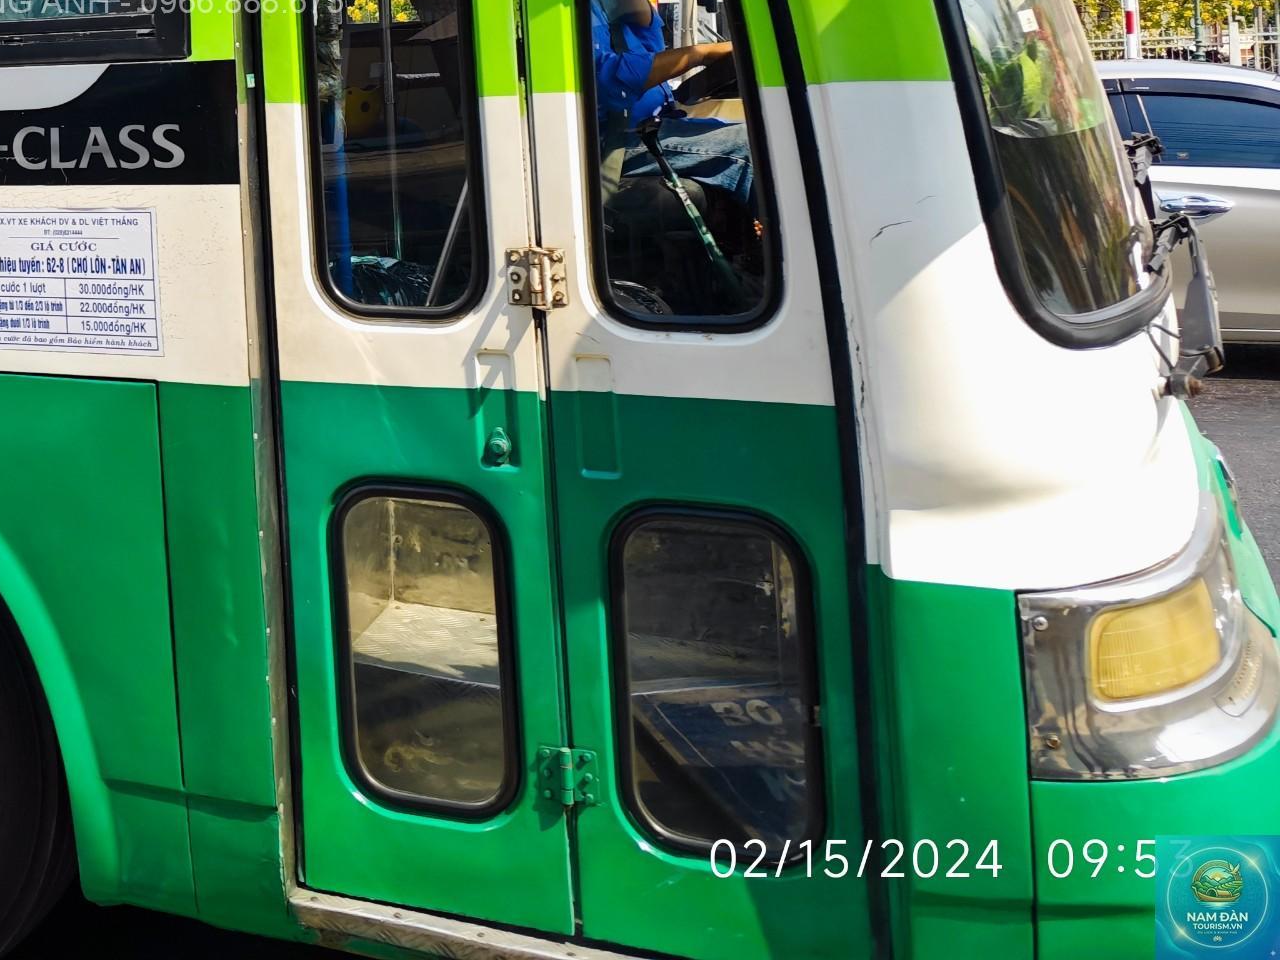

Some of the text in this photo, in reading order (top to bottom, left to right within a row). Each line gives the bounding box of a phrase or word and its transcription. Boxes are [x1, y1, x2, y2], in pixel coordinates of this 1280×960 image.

[19, 218, 28, 226] XE
[30, 216, 57, 226] KHÁCH
[59, 218, 69, 226] DV
[71, 218, 77, 226] &
[79, 218, 89, 226] DL
[92, 217, 108, 227] VIỆT
[111, 216, 139, 226] THẮNG
[31, 241, 97, 251] GIÁ CƯỚC
[0, 256, 17, 273] hiệu
[46, 257, 65, 273] 62-8
[1, 281, 20, 293] cước
[30, 282, 46, 295] lượt
[79, 283, 145, 298] 30.000đồng/HK
[80, 301, 146, 317] 22.000đồng/HK
[81, 320, 148, 335] 15.000đồng/HK
